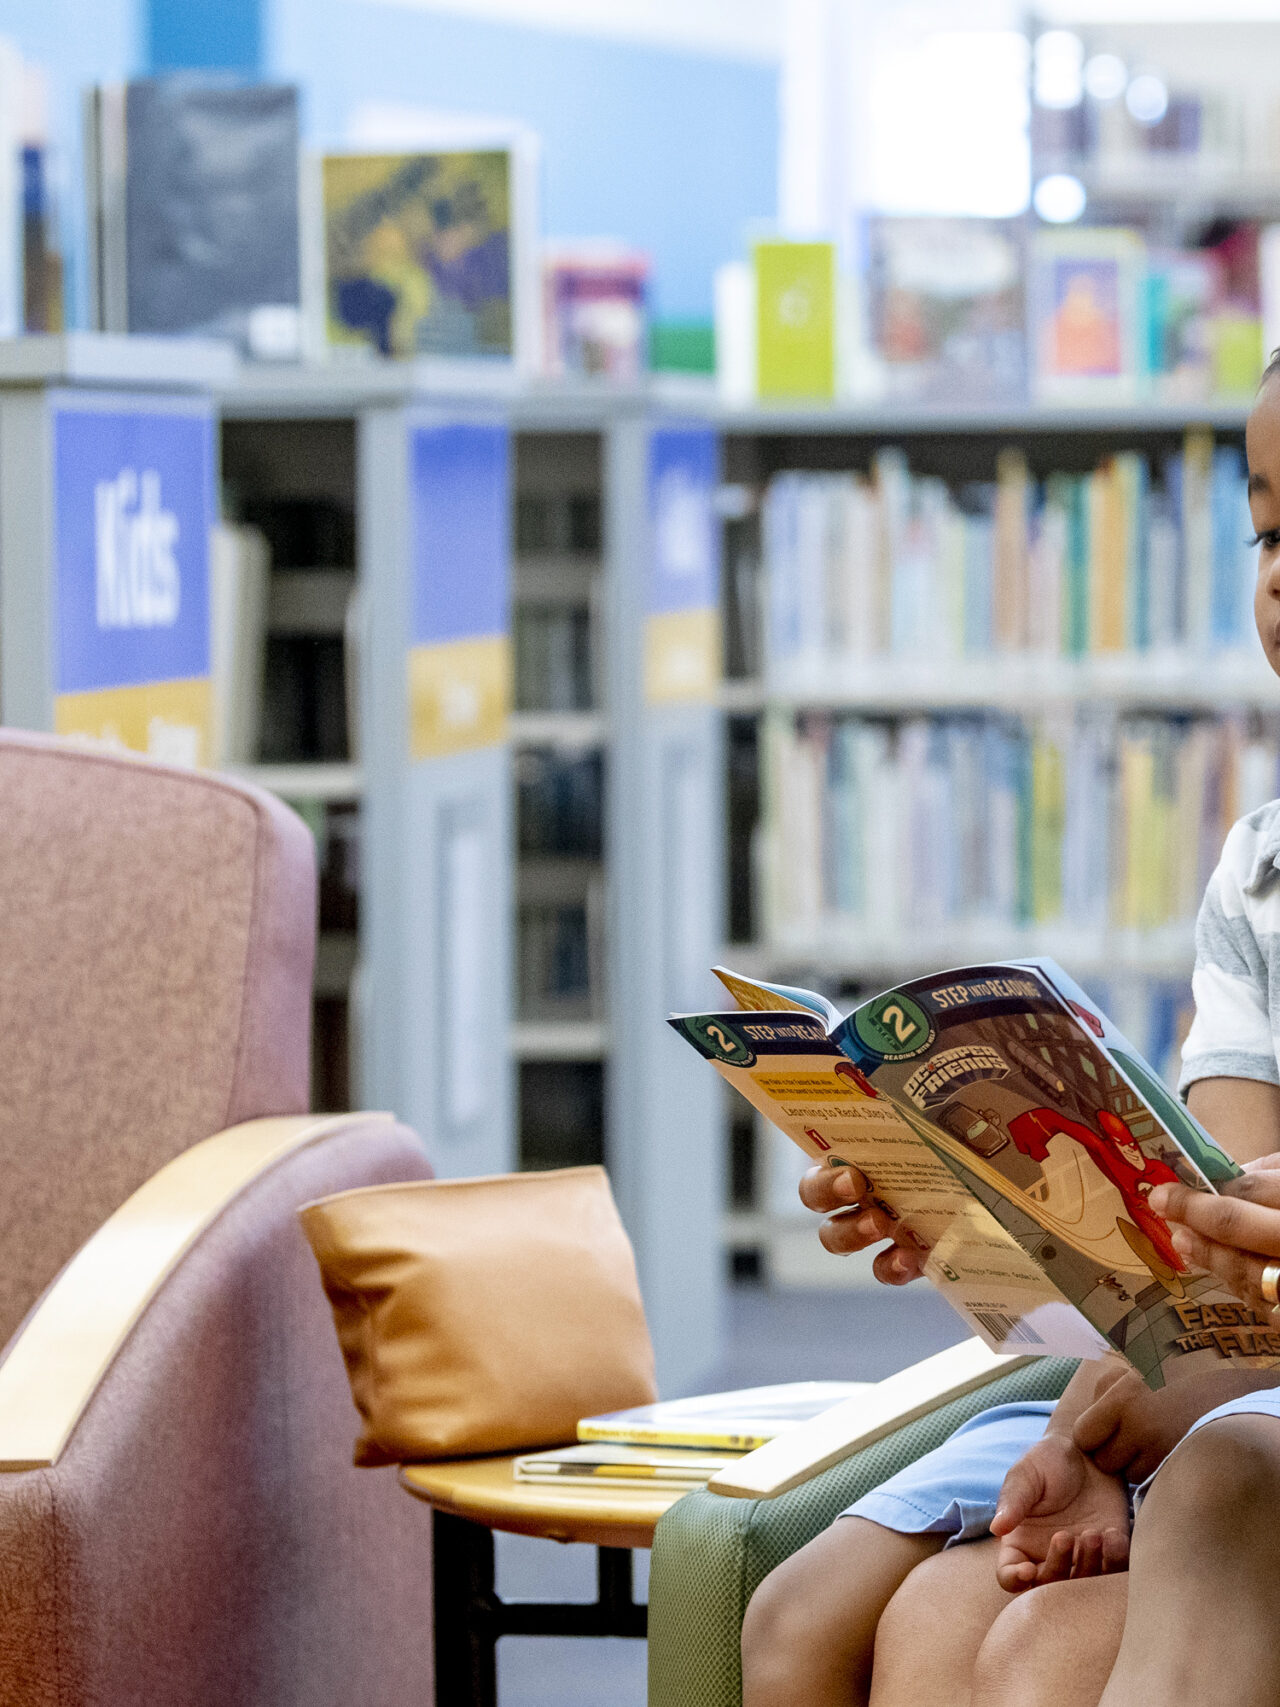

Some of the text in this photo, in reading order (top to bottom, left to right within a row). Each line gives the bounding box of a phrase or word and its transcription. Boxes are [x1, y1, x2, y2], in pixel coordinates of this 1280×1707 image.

[95, 467, 181, 629] Kids
[932, 979, 1041, 1009] STEP INTO READING
[742, 1025, 777, 1041] STEP
[882, 1004, 917, 1042] 2
[706, 1025, 736, 1053] 2
[883, 1050, 917, 1061] READING
[915, 1042, 931, 1055] WITH
[902, 1045, 999, 1097] DC SUPER
[911, 1057, 1010, 1110] FRIENDS
[781, 1106, 828, 1121] Learning
[823, 1108, 837, 1118] to
[834, 1106, 867, 1120] Read,
[1175, 1333, 1214, 1351] THE
